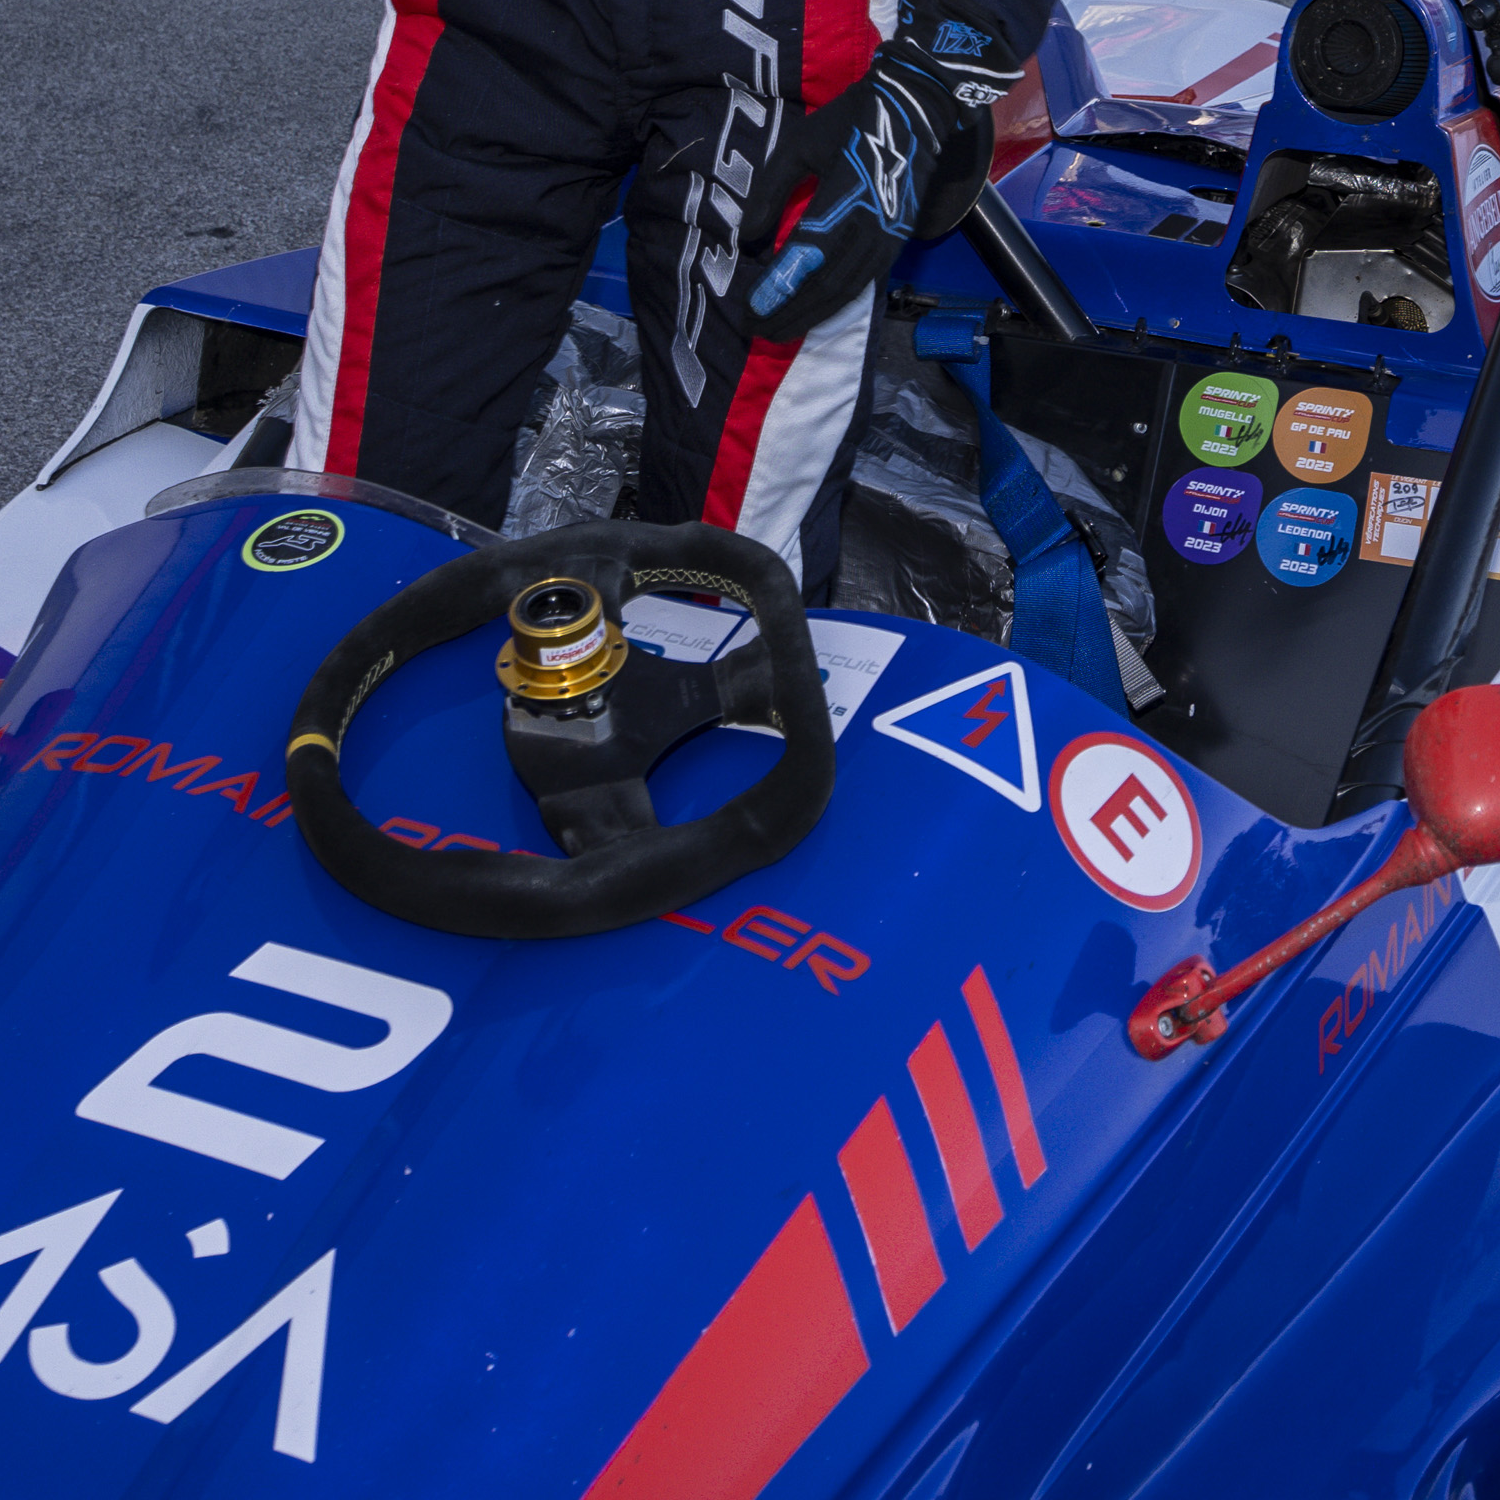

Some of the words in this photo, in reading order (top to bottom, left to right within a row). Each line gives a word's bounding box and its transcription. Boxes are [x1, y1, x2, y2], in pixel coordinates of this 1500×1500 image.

[1198, 406, 1253, 424] MUGELLO
[1290, 422, 1307, 432] GP
[1308, 425, 1326, 436] DE
[1326, 428, 1351, 440] PAU
[1201, 440, 1239, 457] 2023
[1295, 457, 1334, 473] 2023
[1193, 503, 1228, 518] DIJON
[1365, 479, 1379, 545] VÉRIFICATIONS
[1278, 524, 1333, 541] LEDENON
[1184, 536, 1223, 554] 2023
[1279, 559, 1318, 575] 2023
[629, 622, 716, 653] circuit
[817, 651, 880, 676] rcuit
[1090, 773, 1168, 863] E
[75, 941, 453, 1180] 2
